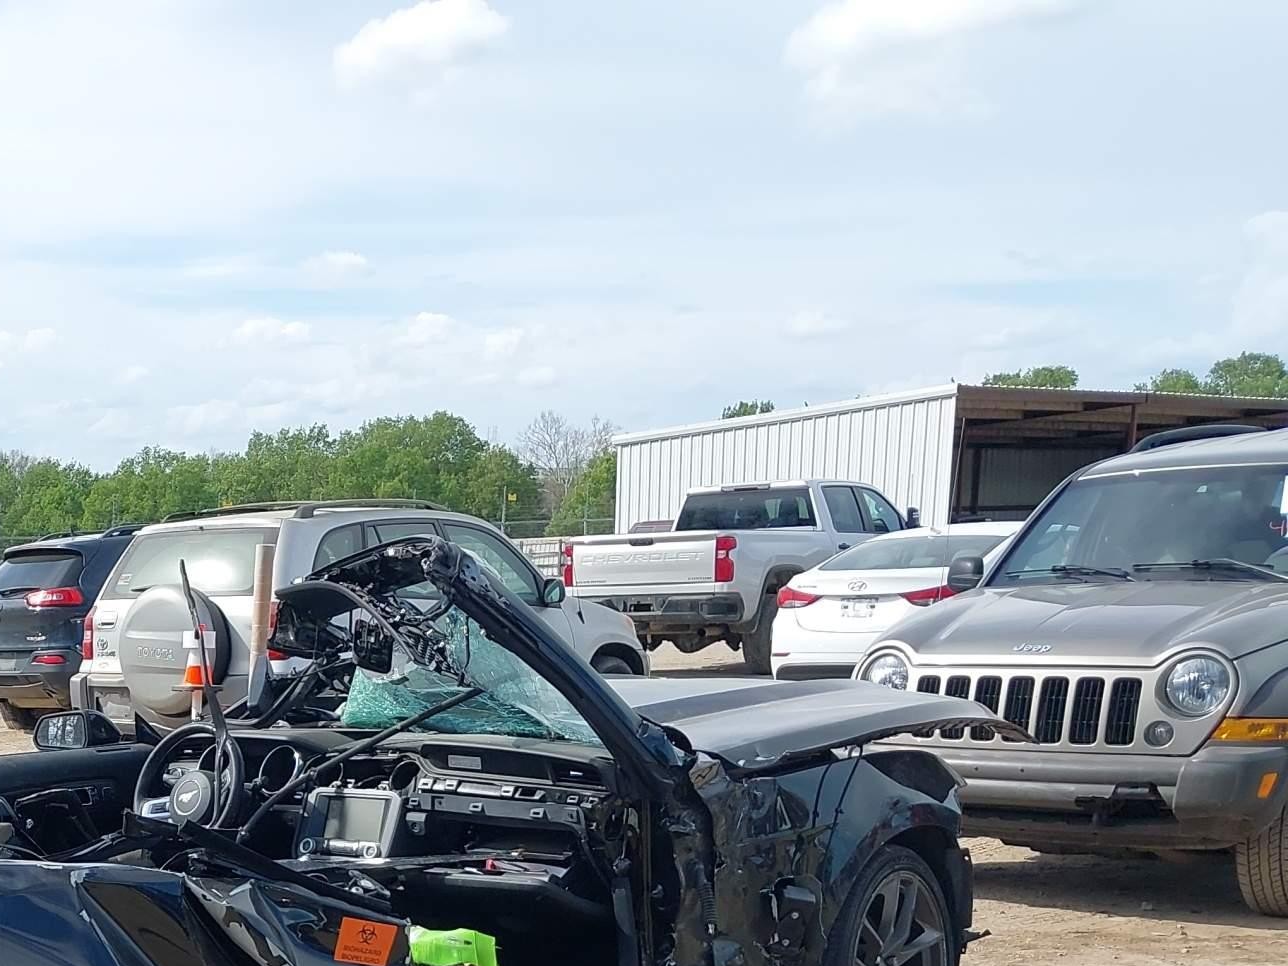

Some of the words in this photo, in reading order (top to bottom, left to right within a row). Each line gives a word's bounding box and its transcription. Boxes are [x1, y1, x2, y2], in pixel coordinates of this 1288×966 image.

[580, 551, 705, 566] CHEVROLET
[136, 645, 175, 661] TOYOTA
[1012, 642, 1052, 653] Jeep
[343, 944, 382, 956] BIOHAZARD
